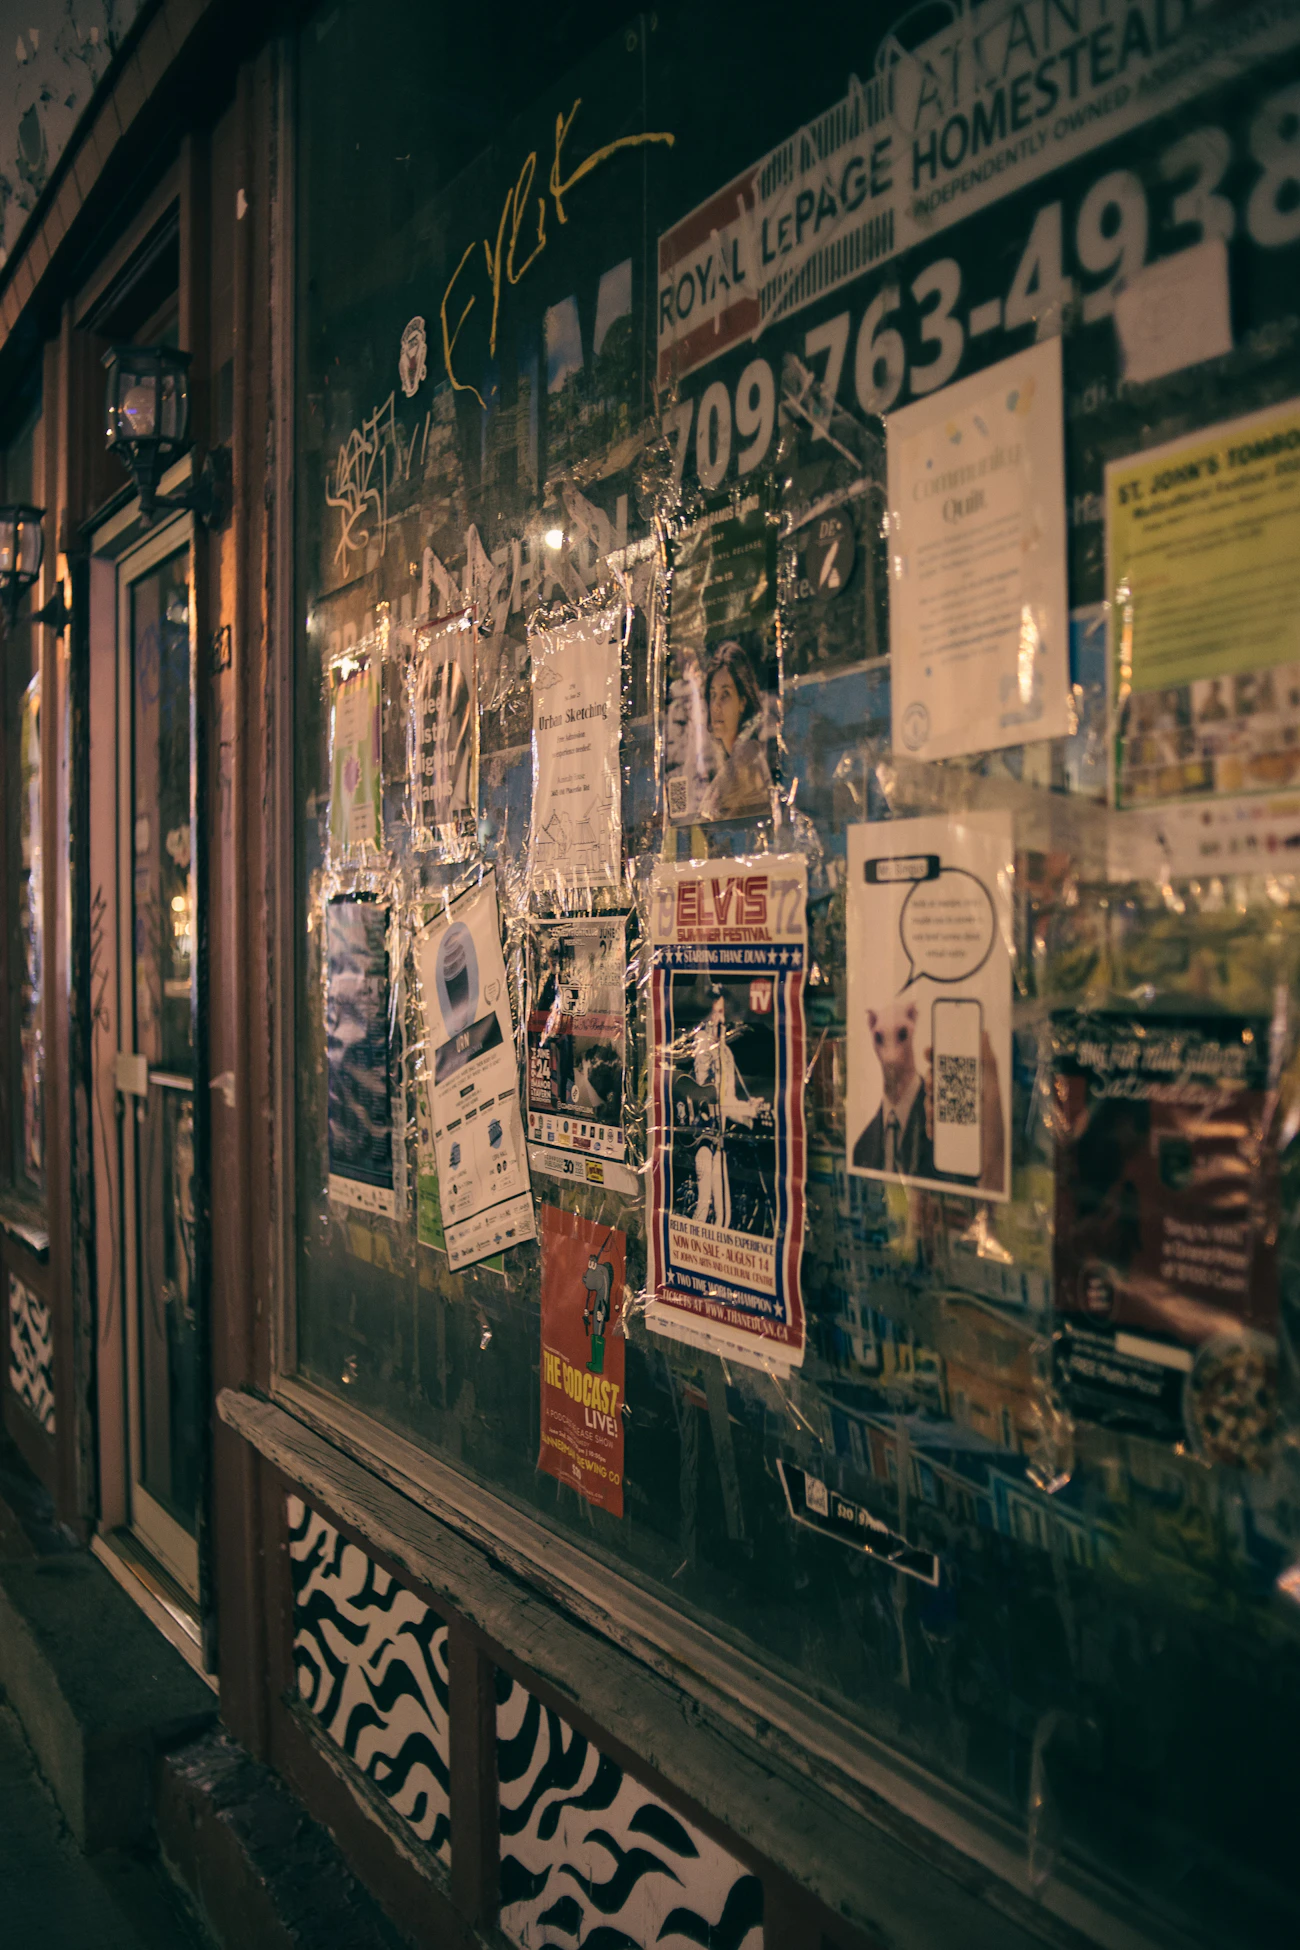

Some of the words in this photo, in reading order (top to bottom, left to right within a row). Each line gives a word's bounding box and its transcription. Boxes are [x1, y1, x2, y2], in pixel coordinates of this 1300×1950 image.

[914, 127, 1048, 217] INDEPENDENTLY
[1053, 84, 1131, 142] OWNED
[659, 236, 746, 335] ROYAL
[912, 443, 1023, 503] Community
[1151, 453, 1219, 495] JOHN'S
[943, 488, 986, 525] Quilt
[732, 540, 762, 556] RELEASE
[538, 714, 563, 731] Urban
[564, 702, 608, 723] Sketching
[657, 886, 675, 937] 19
[676, 876, 768, 927] ELVIS
[770, 878, 802, 935] 72
[599, 927, 615, 939] JUNE
[677, 927, 721, 942] SUMMER
[722, 927, 773, 942] FESTIVAL
[684, 949, 719, 964] STARRING
[719, 949, 744, 964] THANE
[744, 949, 767, 964] DUNN
[750, 991, 771, 1011] TV
[536, 1058, 551, 1080] 24
[563, 1158, 574, 1174] 30
[670, 1220, 688, 1235] RELIVE
[690, 1222, 701, 1237] THE
[701, 1225, 715, 1240] FULL
[716, 1229, 734, 1245] ELVIS
[734, 1232, 774, 1256] EXPERIENCE
[673, 1234, 689, 1250] NOW
[691, 1238, 702, 1252] ON
[703, 1242, 719, 1257] SALE
[726, 1248, 756, 1269] AUGUST
[758, 1256, 769, 1272] 14
[672, 1250, 680, 1262] ST
[680, 1252, 698, 1267] JOHN'S
[699, 1257, 712, 1269] ARTS
[713, 1260, 723, 1272] AND
[723, 1263, 751, 1278] CULTURAL
[752, 1271, 773, 1286] CENTRE
[662, 1288, 692, 1308] TICKETS
[693, 1297, 703, 1312] AT
[675, 1271, 692, 1287] TWO
[692, 1276, 707, 1292] TIME
[708, 1280, 733, 1300] WORLD
[733, 1290, 772, 1314] CHAMPION
[543, 1350, 562, 1390] THE
[584, 1407, 618, 1439] LIVE!
[594, 1434, 615, 1449] SHOW
[608, 1470, 620, 1486] CO
[837, 1502, 854, 1521] $20
